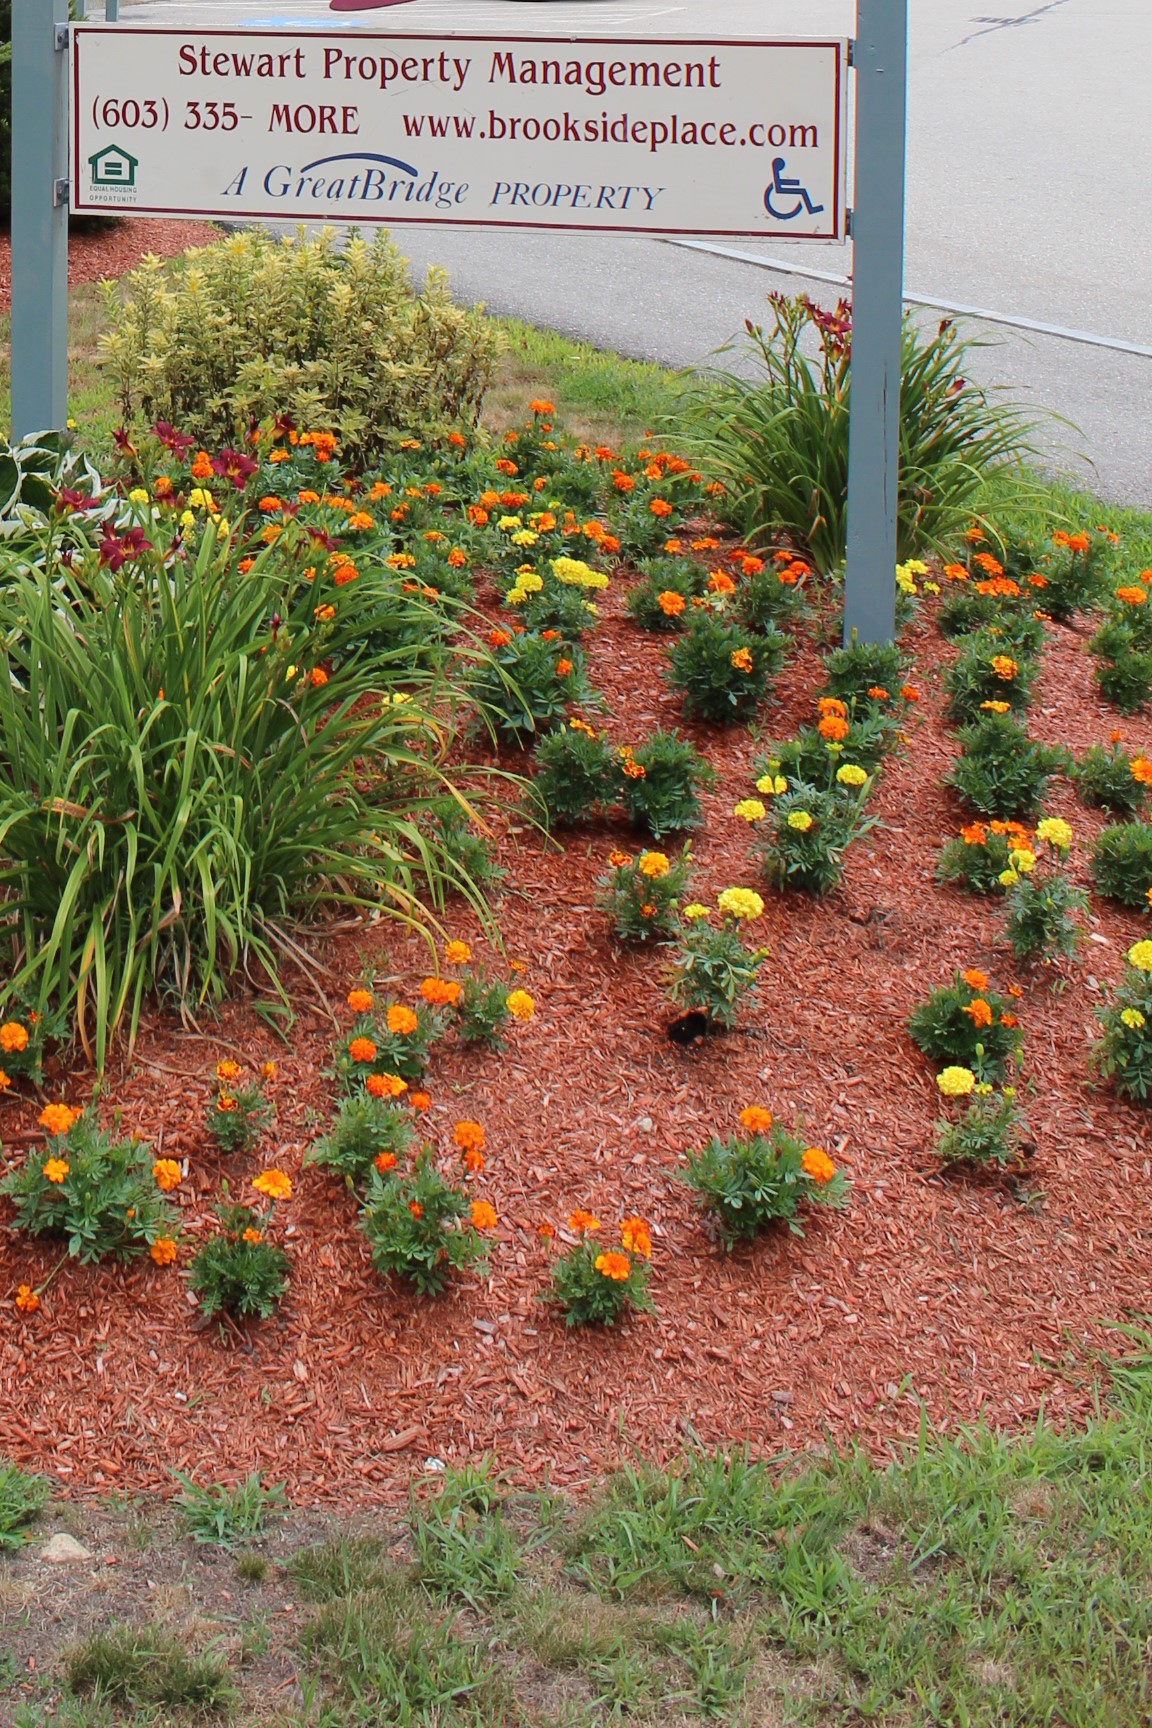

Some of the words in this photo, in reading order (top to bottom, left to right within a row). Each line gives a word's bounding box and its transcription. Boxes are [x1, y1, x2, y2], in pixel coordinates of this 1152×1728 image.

[177, 44, 306, 78] Stewart
[322, 48, 472, 92] Property
[488, 51, 722, 96] Management
[92, 95, 170, 132] (603)
[268, 103, 361, 135] MORE
[402, 109, 820, 152] www.brooksideplace.com
[89, 194, 137, 202] OPPORTUNITY
[221, 165, 249, 196] A
[263, 164, 470, 209] GreatBridge
[489, 181, 667, 212] PROPERTY
